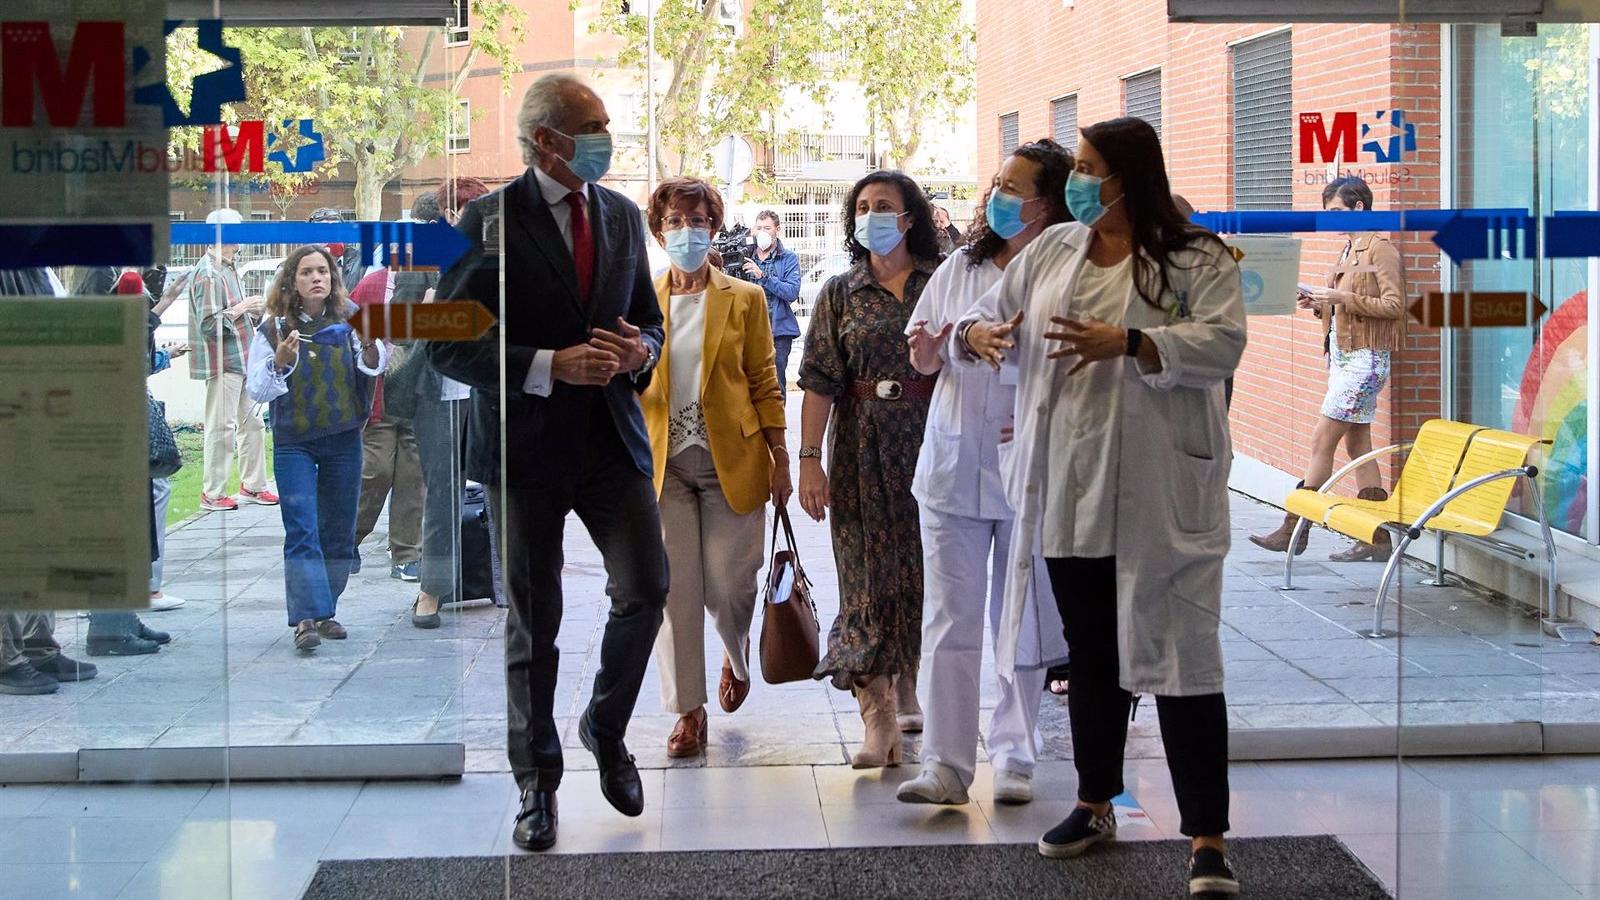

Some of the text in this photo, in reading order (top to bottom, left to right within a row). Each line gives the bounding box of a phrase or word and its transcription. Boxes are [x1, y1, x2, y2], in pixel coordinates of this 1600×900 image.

[1, 21, 126, 128] M
[203, 120, 265, 173] M
[1300, 112, 1358, 163] M
[415, 311, 468, 329] SIAC
[1471, 302, 1523, 318] SIAC
